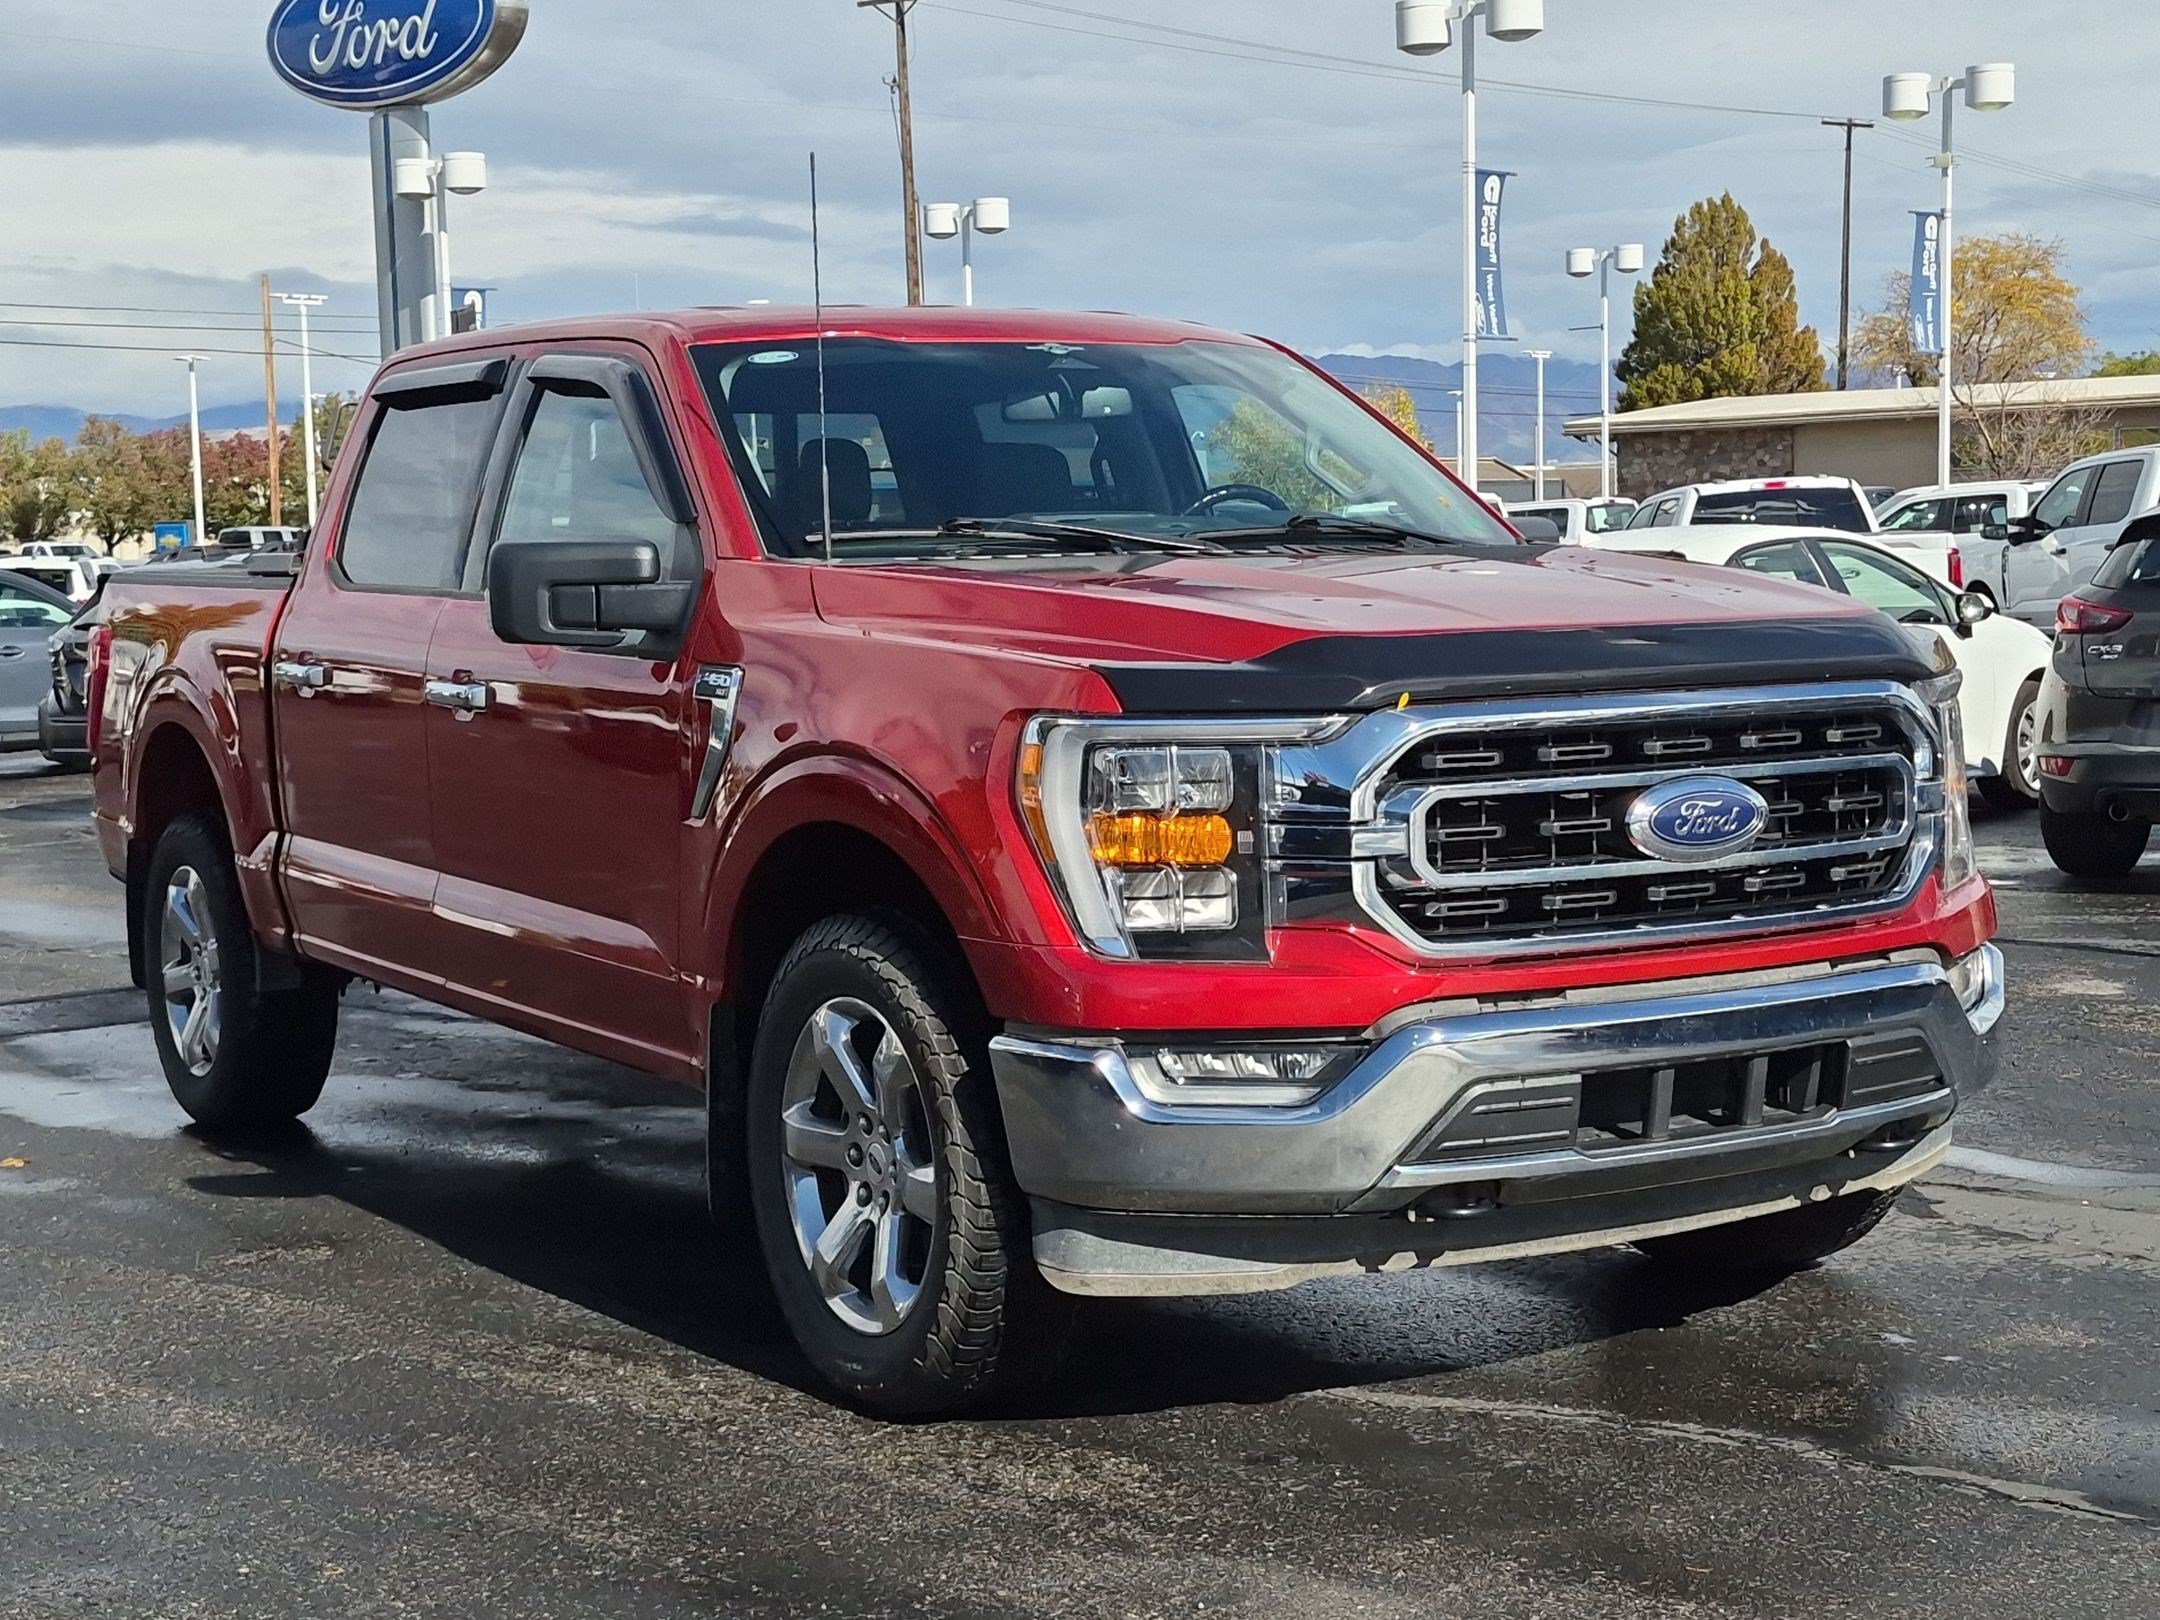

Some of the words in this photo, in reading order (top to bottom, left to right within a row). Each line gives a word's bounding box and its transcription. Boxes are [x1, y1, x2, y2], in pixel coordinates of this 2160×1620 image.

[308, 0, 438, 75] Ford
[1480, 205, 1491, 247] Ford
[1489, 205, 1498, 230] Ken
[1488, 232, 1497, 264] Garff
[1922, 240, 1931, 276] Ford
[1486, 274, 1495, 302] West
[1673, 799, 1741, 836] Ford
